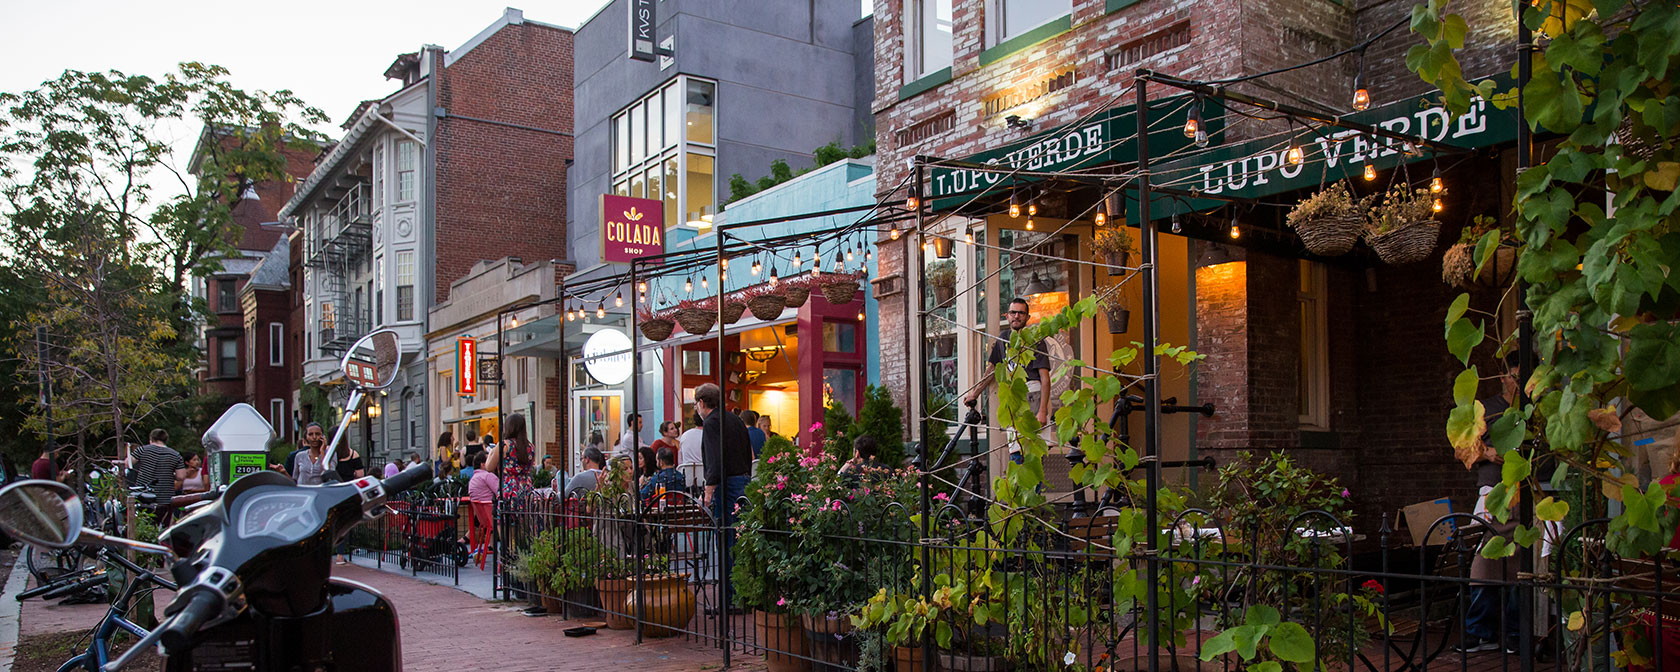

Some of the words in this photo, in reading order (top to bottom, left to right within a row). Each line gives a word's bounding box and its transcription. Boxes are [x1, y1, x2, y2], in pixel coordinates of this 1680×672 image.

[937, 157, 1000, 196] LUPO
[1006, 124, 1103, 171] VERDE
[1200, 145, 1304, 194] LUPO
[1315, 96, 1487, 168] VERDE
[607, 221, 661, 246] COLADA
[624, 247, 643, 255] SHOP
[464, 342, 472, 391] TAQUERIA
